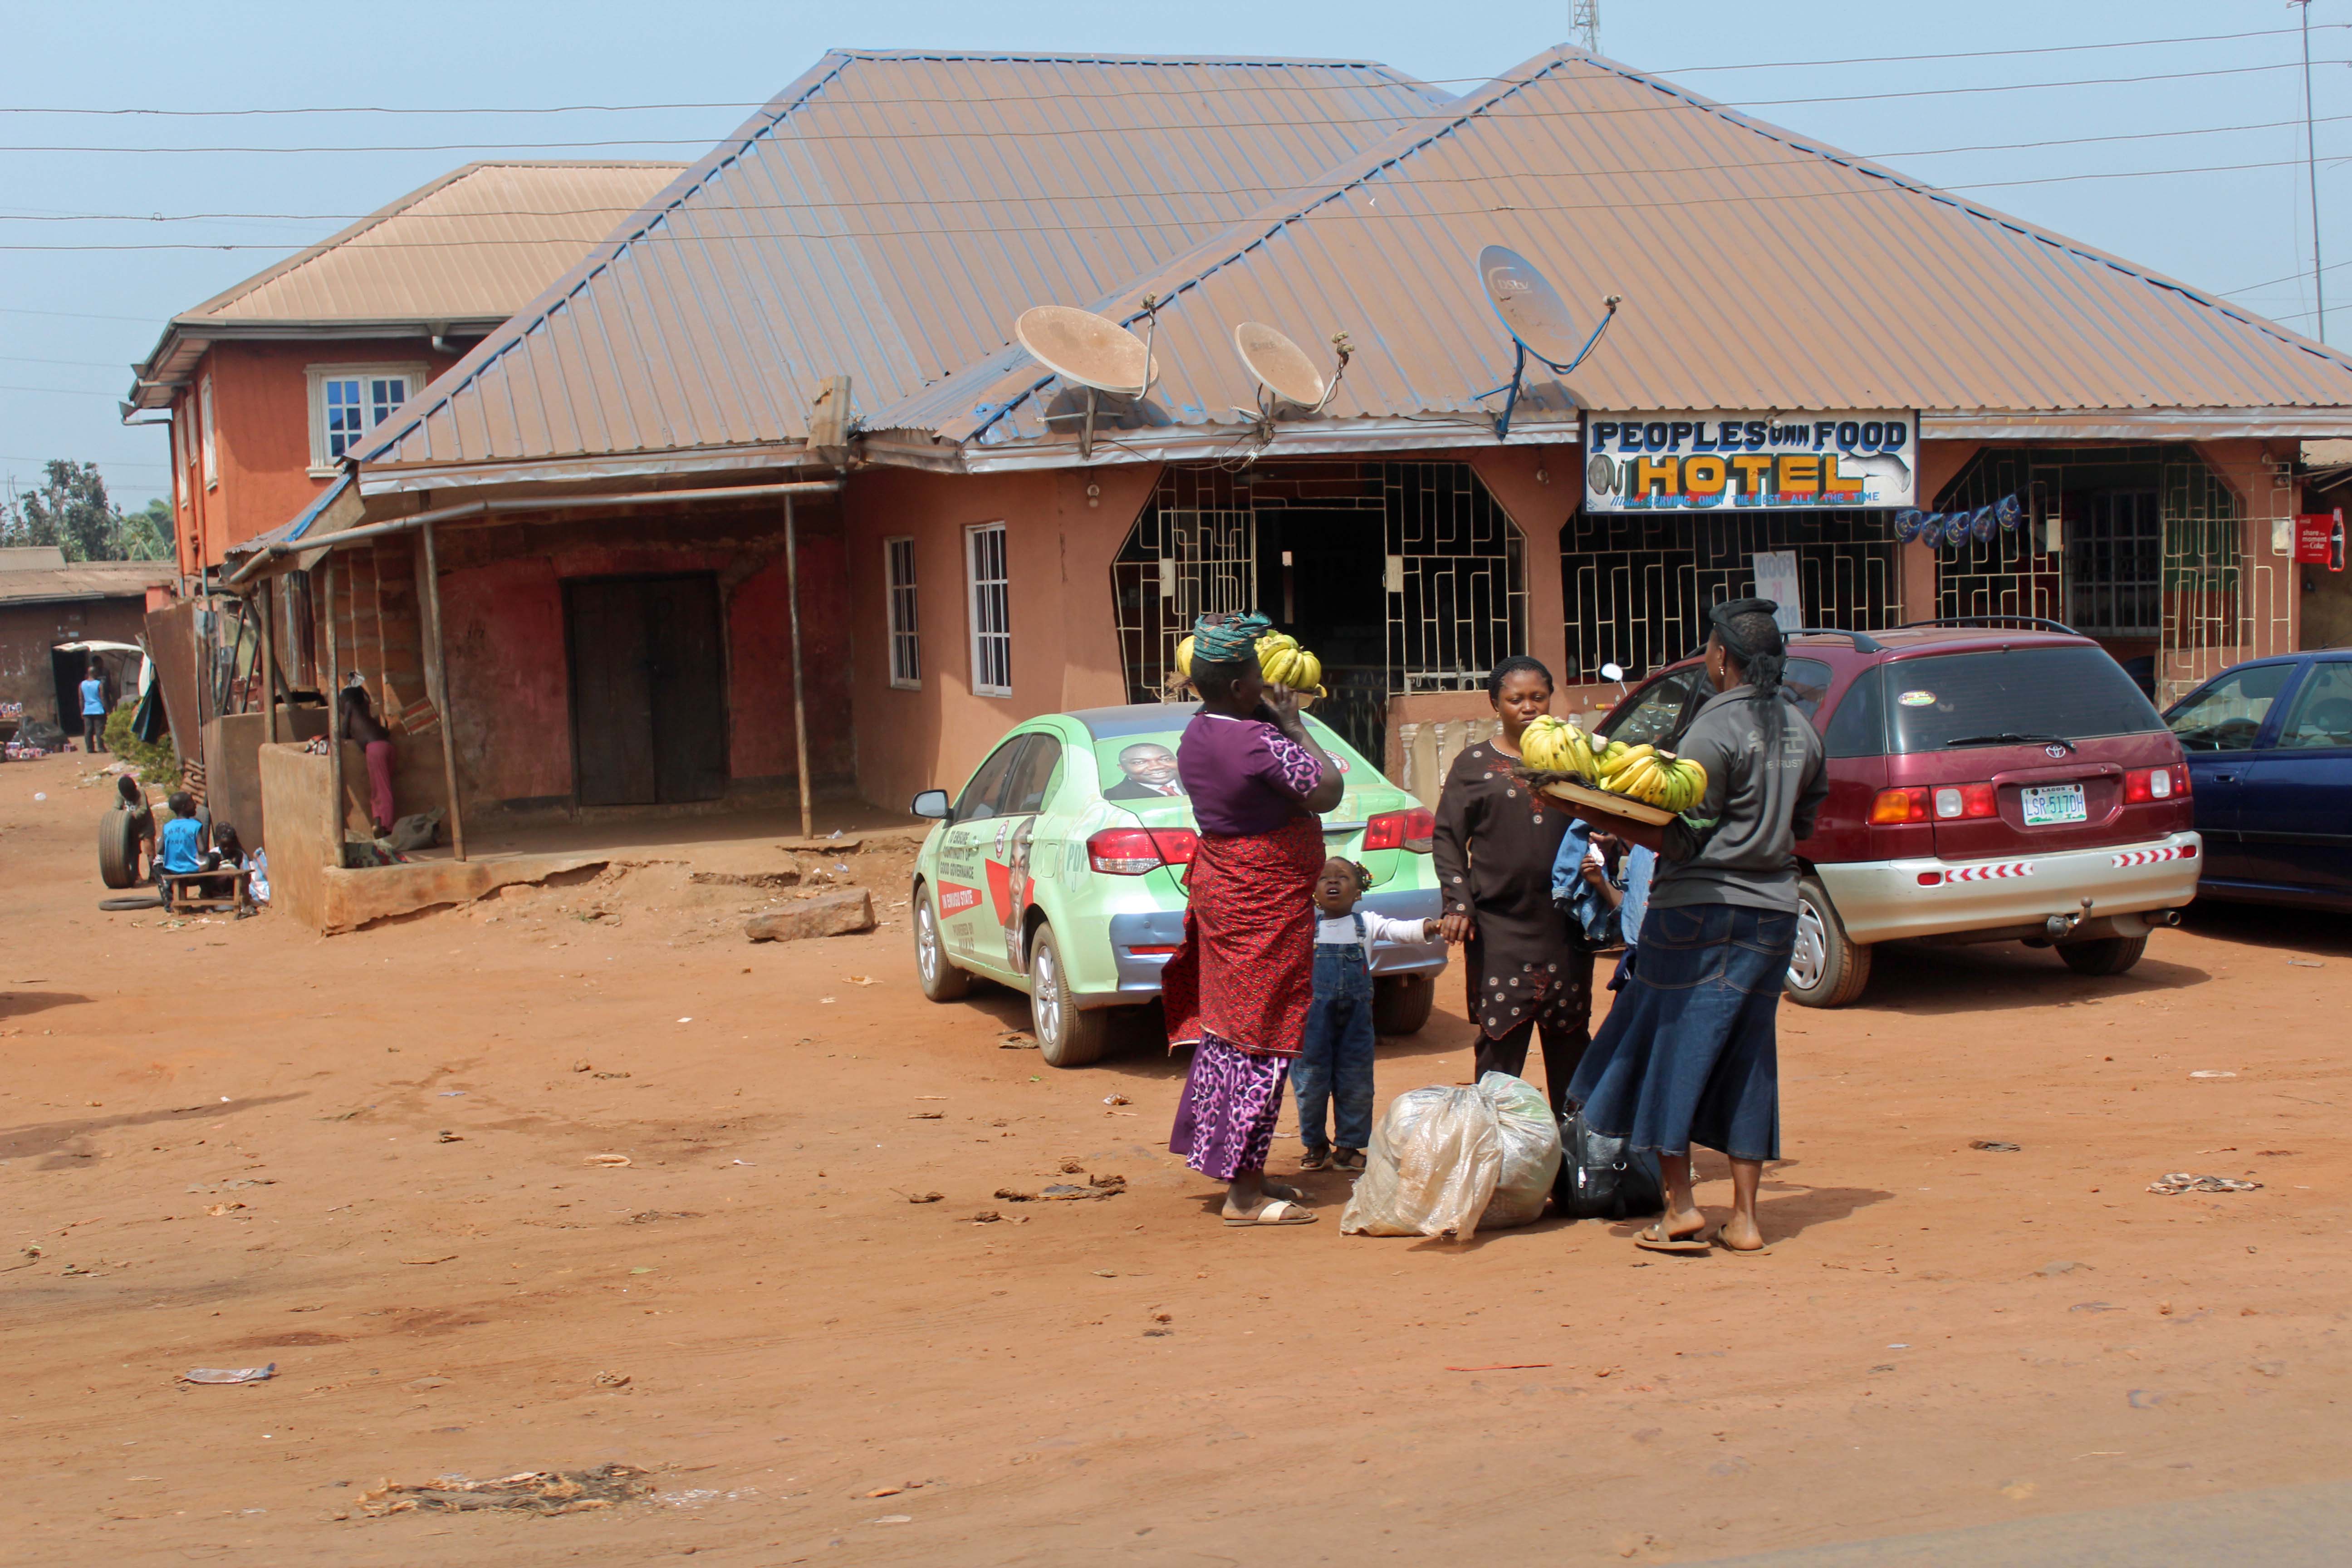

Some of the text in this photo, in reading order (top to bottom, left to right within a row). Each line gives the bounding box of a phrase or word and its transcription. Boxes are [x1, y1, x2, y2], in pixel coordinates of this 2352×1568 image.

[1591, 421, 1768, 453] PEOPLES
[1813, 421, 1906, 452] FOOD
[1627, 453, 1863, 505] HOTEL
[1647, 495, 1690, 507] SERVING
[1698, 495, 1724, 506] ONLY
[1731, 495, 1749, 505] THE
[1754, 494, 1781, 505] BEST
[1790, 494, 1814, 505] ALL
[1823, 493, 1844, 504] THE
[1852, 491, 1880, 502] TIME
[2025, 794, 2084, 816] LSR-517DH
[953, 831, 970, 845] ENSURE
[940, 862, 974, 880] GOOD GOVERNANCE
[960, 889, 973, 906] STATE
